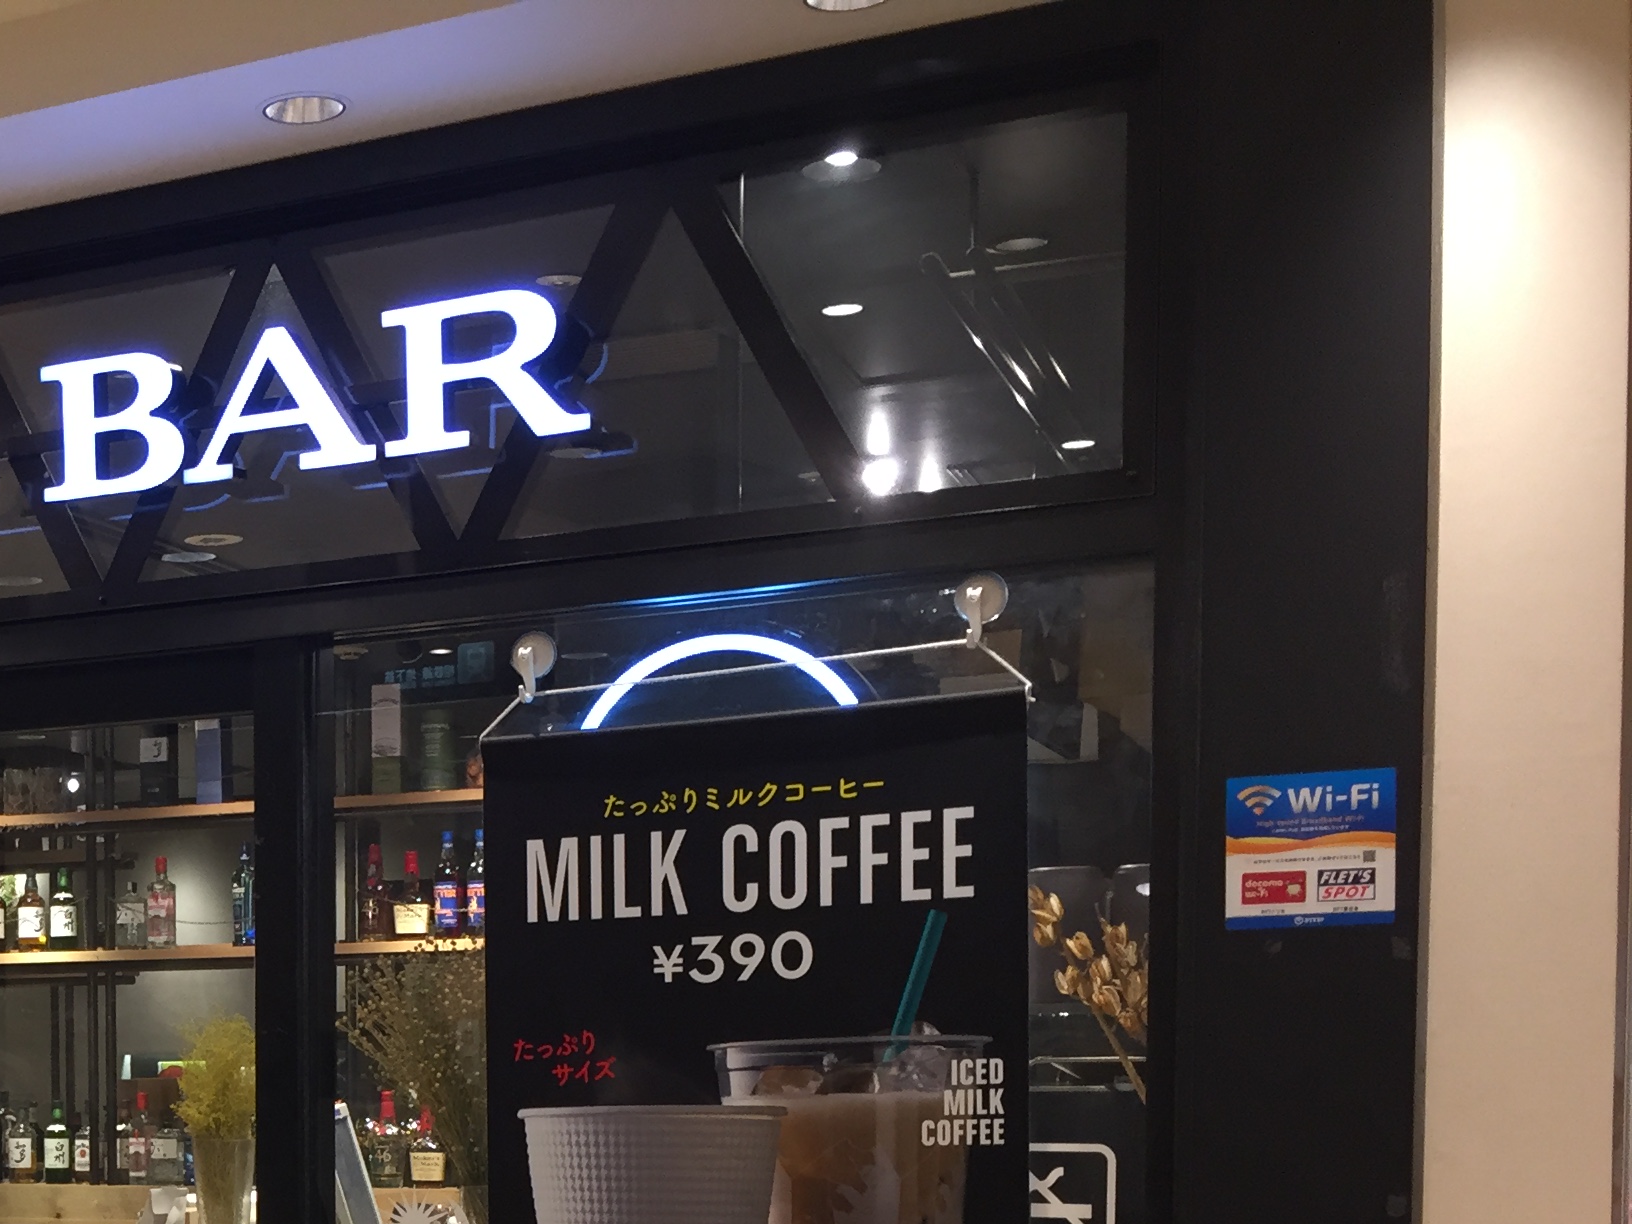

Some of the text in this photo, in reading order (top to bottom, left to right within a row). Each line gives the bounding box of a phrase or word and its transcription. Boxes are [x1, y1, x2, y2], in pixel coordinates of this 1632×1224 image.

[40, 288, 593, 502] BAR
[603, 777, 885, 819] たっぷりミルクコーヒー
[1287, 783, 1380, 814] Wi-Fi
[525, 806, 975, 924] MILK COFFEE
[1319, 869, 1372, 885] FLET'S
[1322, 885, 1371, 900] SPOT
[652, 930, 814, 983] ¥390
[513, 1030, 596, 1063] たっぷり
[552, 1056, 617, 1088] サイズ
[951, 1057, 1005, 1087] ICED
[943, 1088, 1005, 1117] MILK
[921, 1118, 1006, 1147] COFFEE
